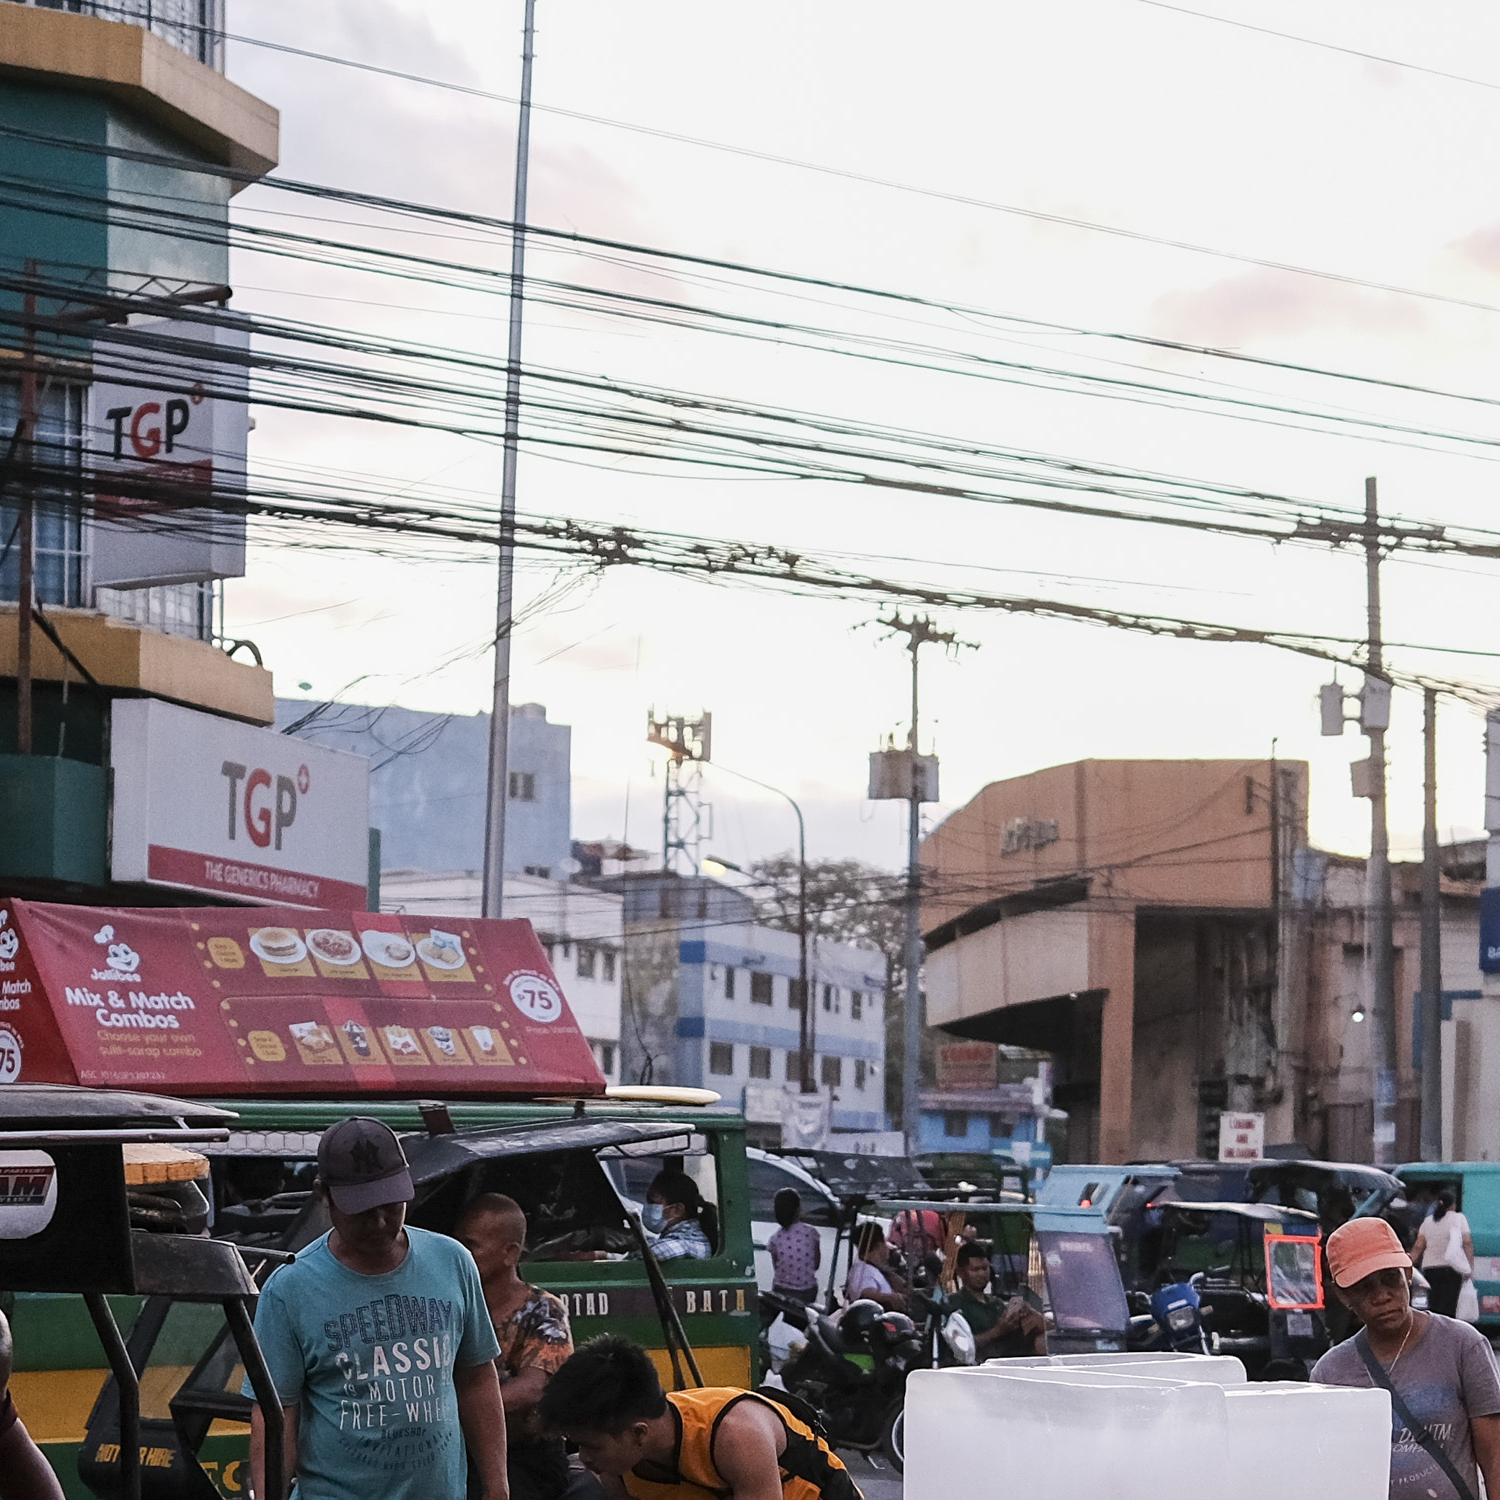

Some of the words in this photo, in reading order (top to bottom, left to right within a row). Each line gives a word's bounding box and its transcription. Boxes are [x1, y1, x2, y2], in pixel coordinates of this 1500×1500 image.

[105, 398, 190, 460] TGP
[220, 760, 297, 851] TGP
[204, 860, 224, 882] THE
[224, 865, 268, 889] GENERICS
[2, 978, 32, 994] Match
[91, 969, 142, 982] Jollibee
[64, 986, 102, 1008] Mix
[108, 990, 126, 1008] &
[128, 991, 196, 1010] Match
[96, 1009, 180, 1028] Combos
[323, 1293, 452, 1352] SPEEDWAY
[368, 1374, 435, 1402] MOTOR
[95, 1443, 121, 1463] NOT
